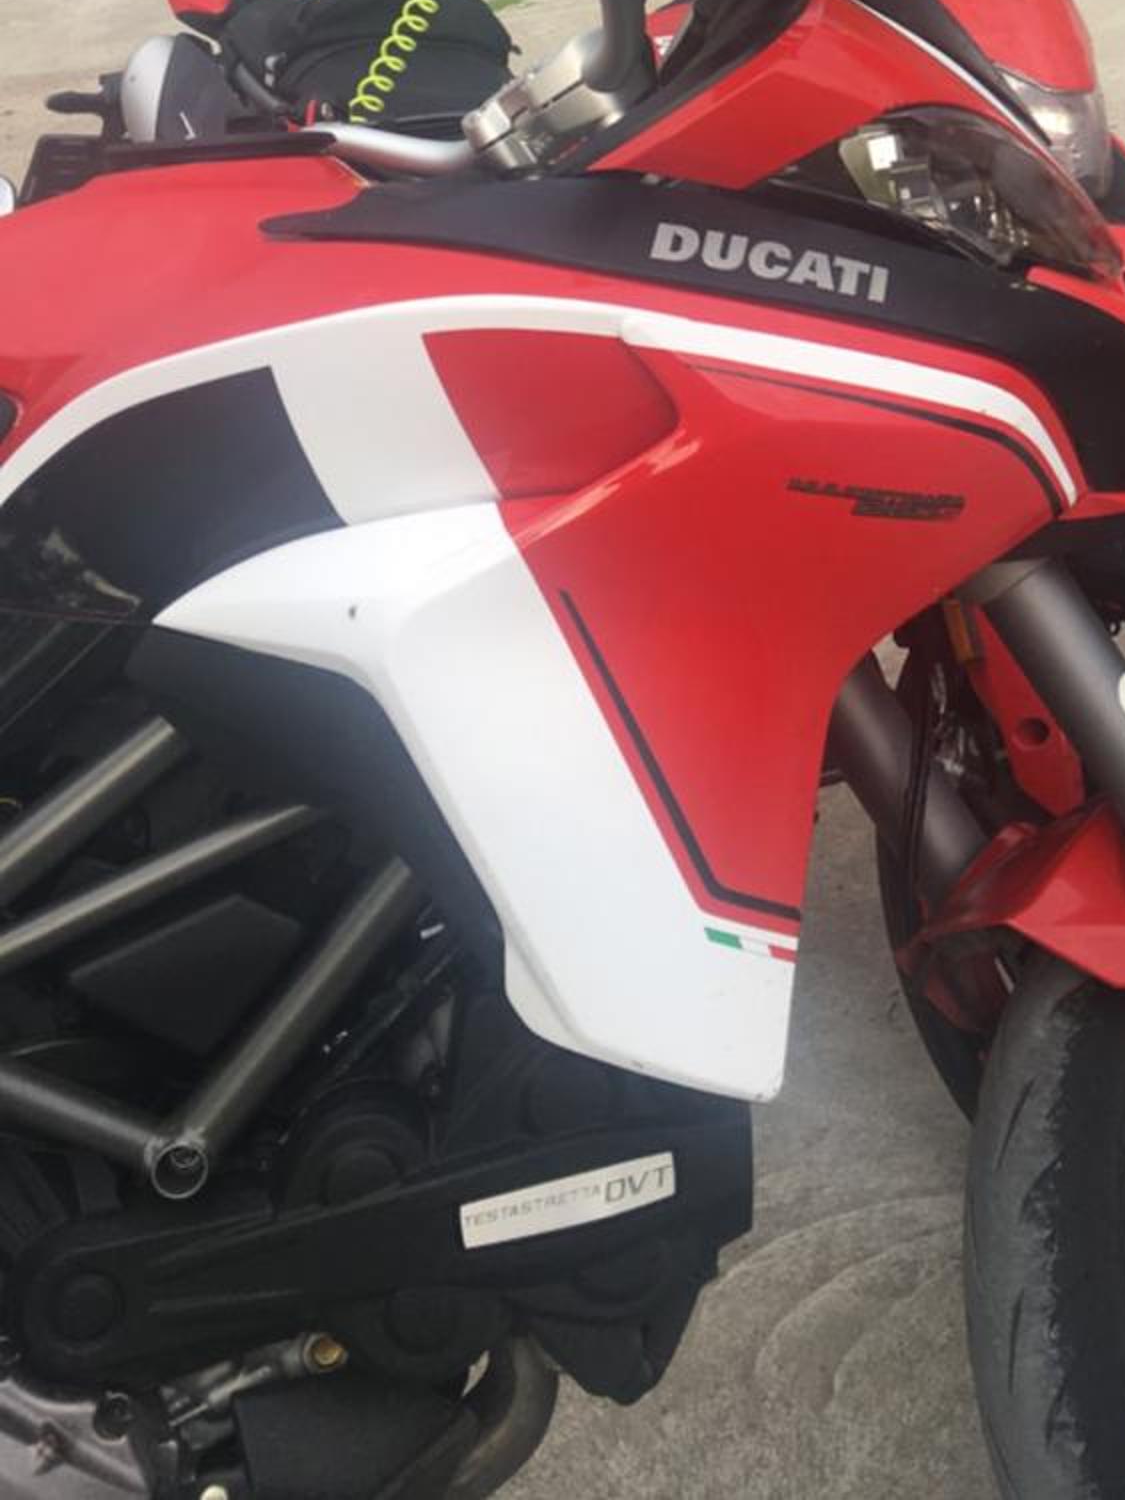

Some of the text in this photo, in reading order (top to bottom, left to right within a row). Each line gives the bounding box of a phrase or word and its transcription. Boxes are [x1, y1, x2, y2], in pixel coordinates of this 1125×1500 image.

[650, 222, 889, 303] DUCATI
[464, 1164, 673, 1228] TESTASTRETTA DVT
